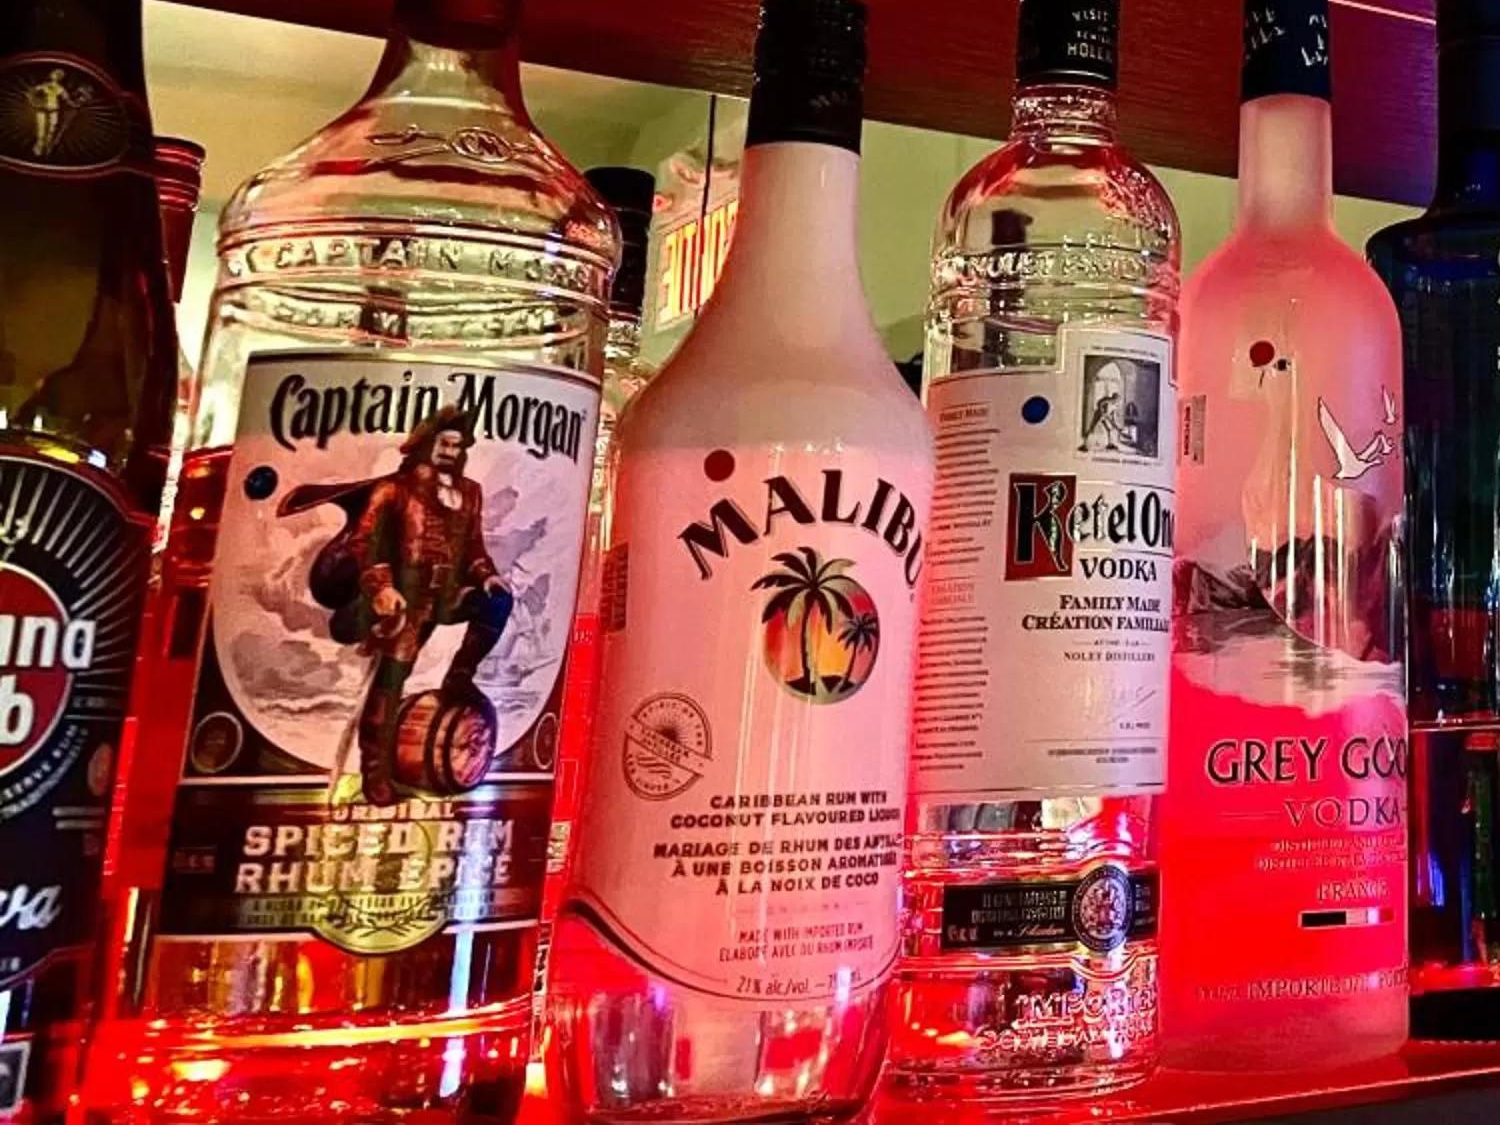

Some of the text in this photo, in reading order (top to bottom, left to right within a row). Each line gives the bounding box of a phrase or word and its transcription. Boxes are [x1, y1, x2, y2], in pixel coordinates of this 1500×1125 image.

[270, 370, 585, 466] Captain Morgan
[1013, 480, 1136, 573] Ketel
[1141, 490, 1174, 548] On
[1080, 558, 1158, 582] VODKA
[1060, 594, 1161, 612] FAMILY MADE
[1022, 611, 1114, 632] CRÉATION
[1064, 652, 1102, 662] NOLET
[1206, 737, 1328, 785] GREY
[710, 791, 887, 809] CARIBBEAN RUM WITH
[1285, 796, 1400, 826] VODKA
[670, 810, 866, 829] COCONUT FLAVOURED
[243, 822, 414, 856] SPICED
[653, 841, 740, 859] MARIAGE
[748, 841, 774, 856] DE
[780, 838, 829, 854] RHUM
[834, 836, 860, 852] DES
[235, 861, 378, 893] RHUM
[692, 861, 731, 876] UNE
[740, 858, 822, 875] BOISSON
[737, 880, 762, 894] LA
[771, 876, 816, 892] NOIX
[821, 875, 842, 890] DE
[845, 872, 879, 888] COCO
[1317, 879, 1389, 902] FRANCE
